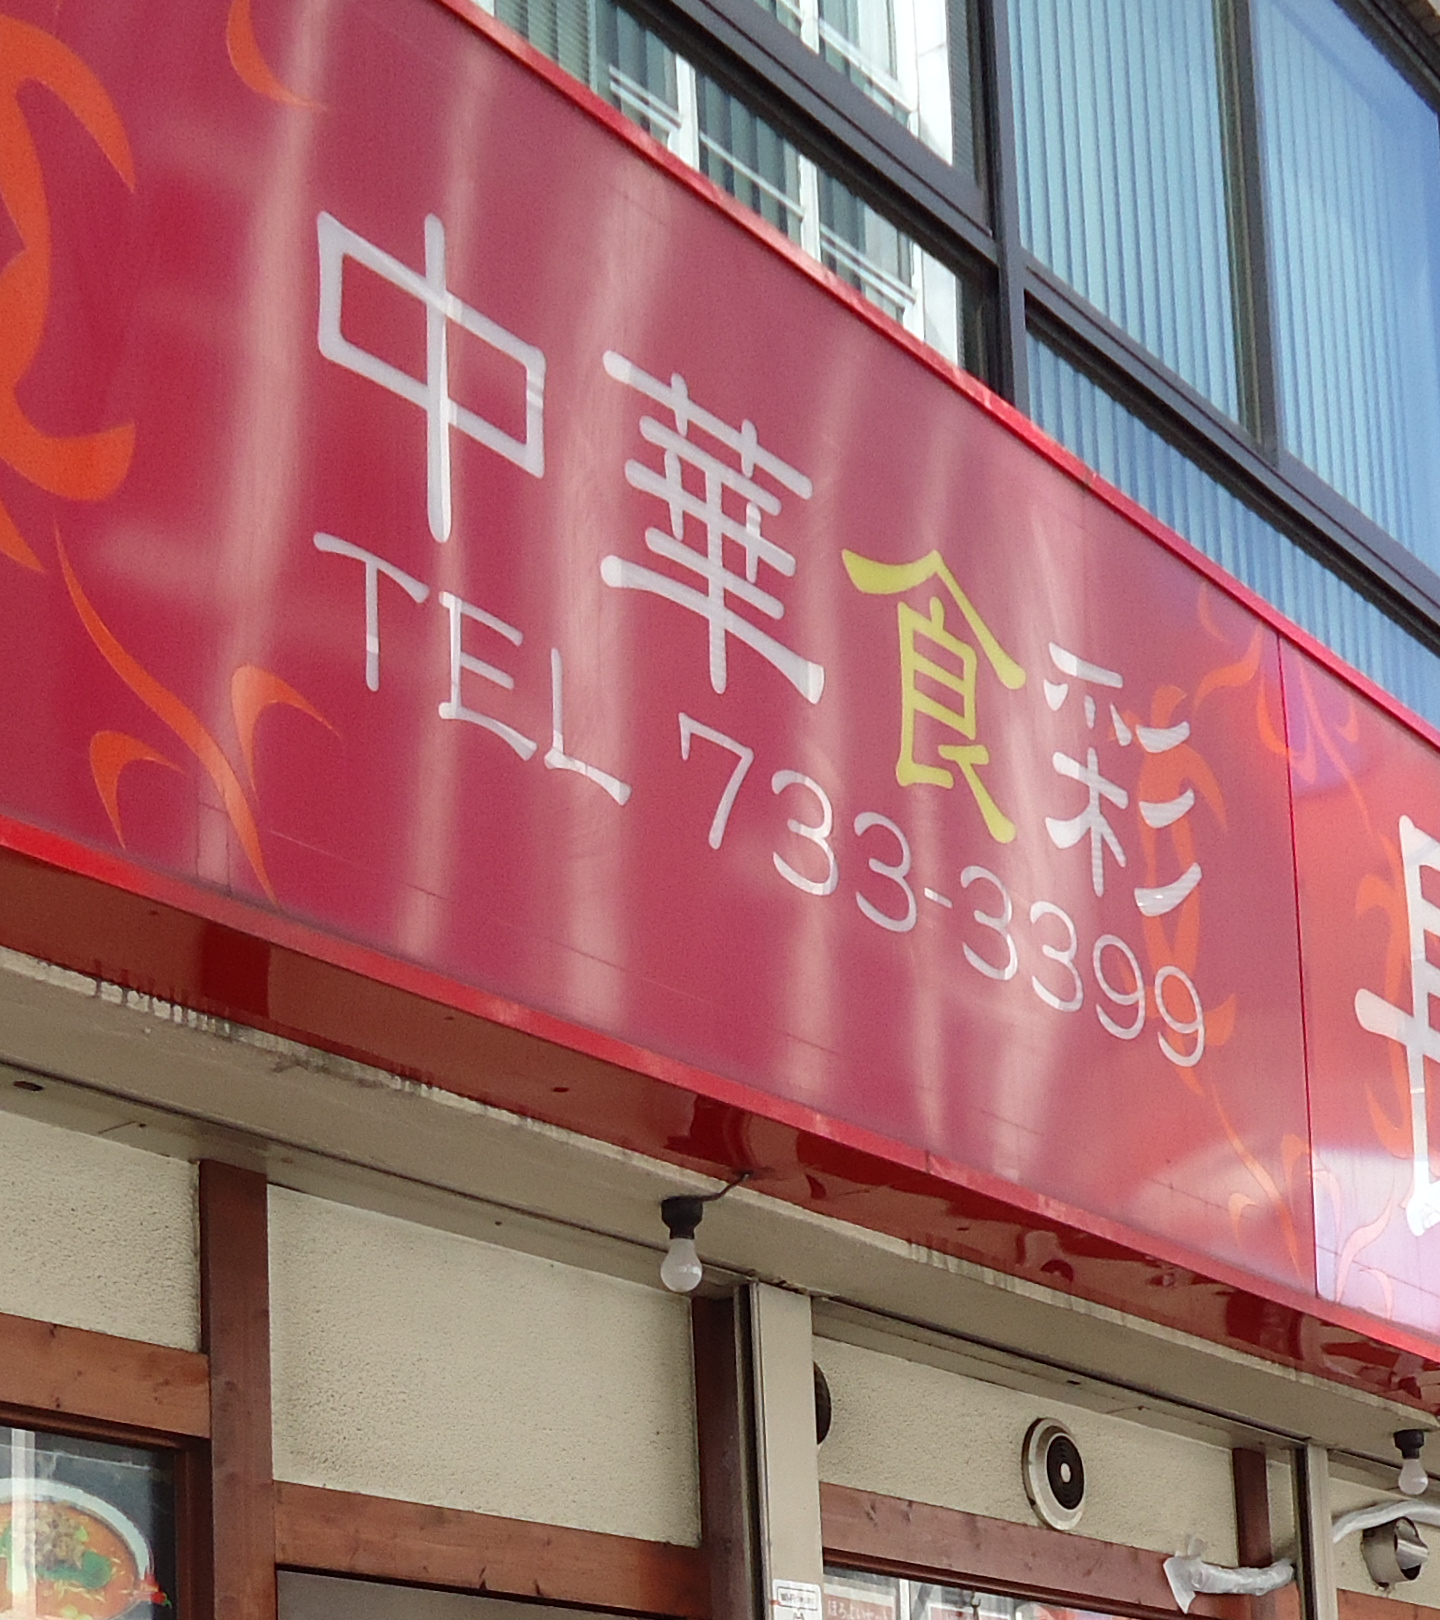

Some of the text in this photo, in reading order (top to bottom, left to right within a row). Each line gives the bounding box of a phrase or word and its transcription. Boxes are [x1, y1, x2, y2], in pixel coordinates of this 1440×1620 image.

[313, 531, 1205, 1068] TEL 733-3399
[315, 210, 1202, 915] 中華食彩
